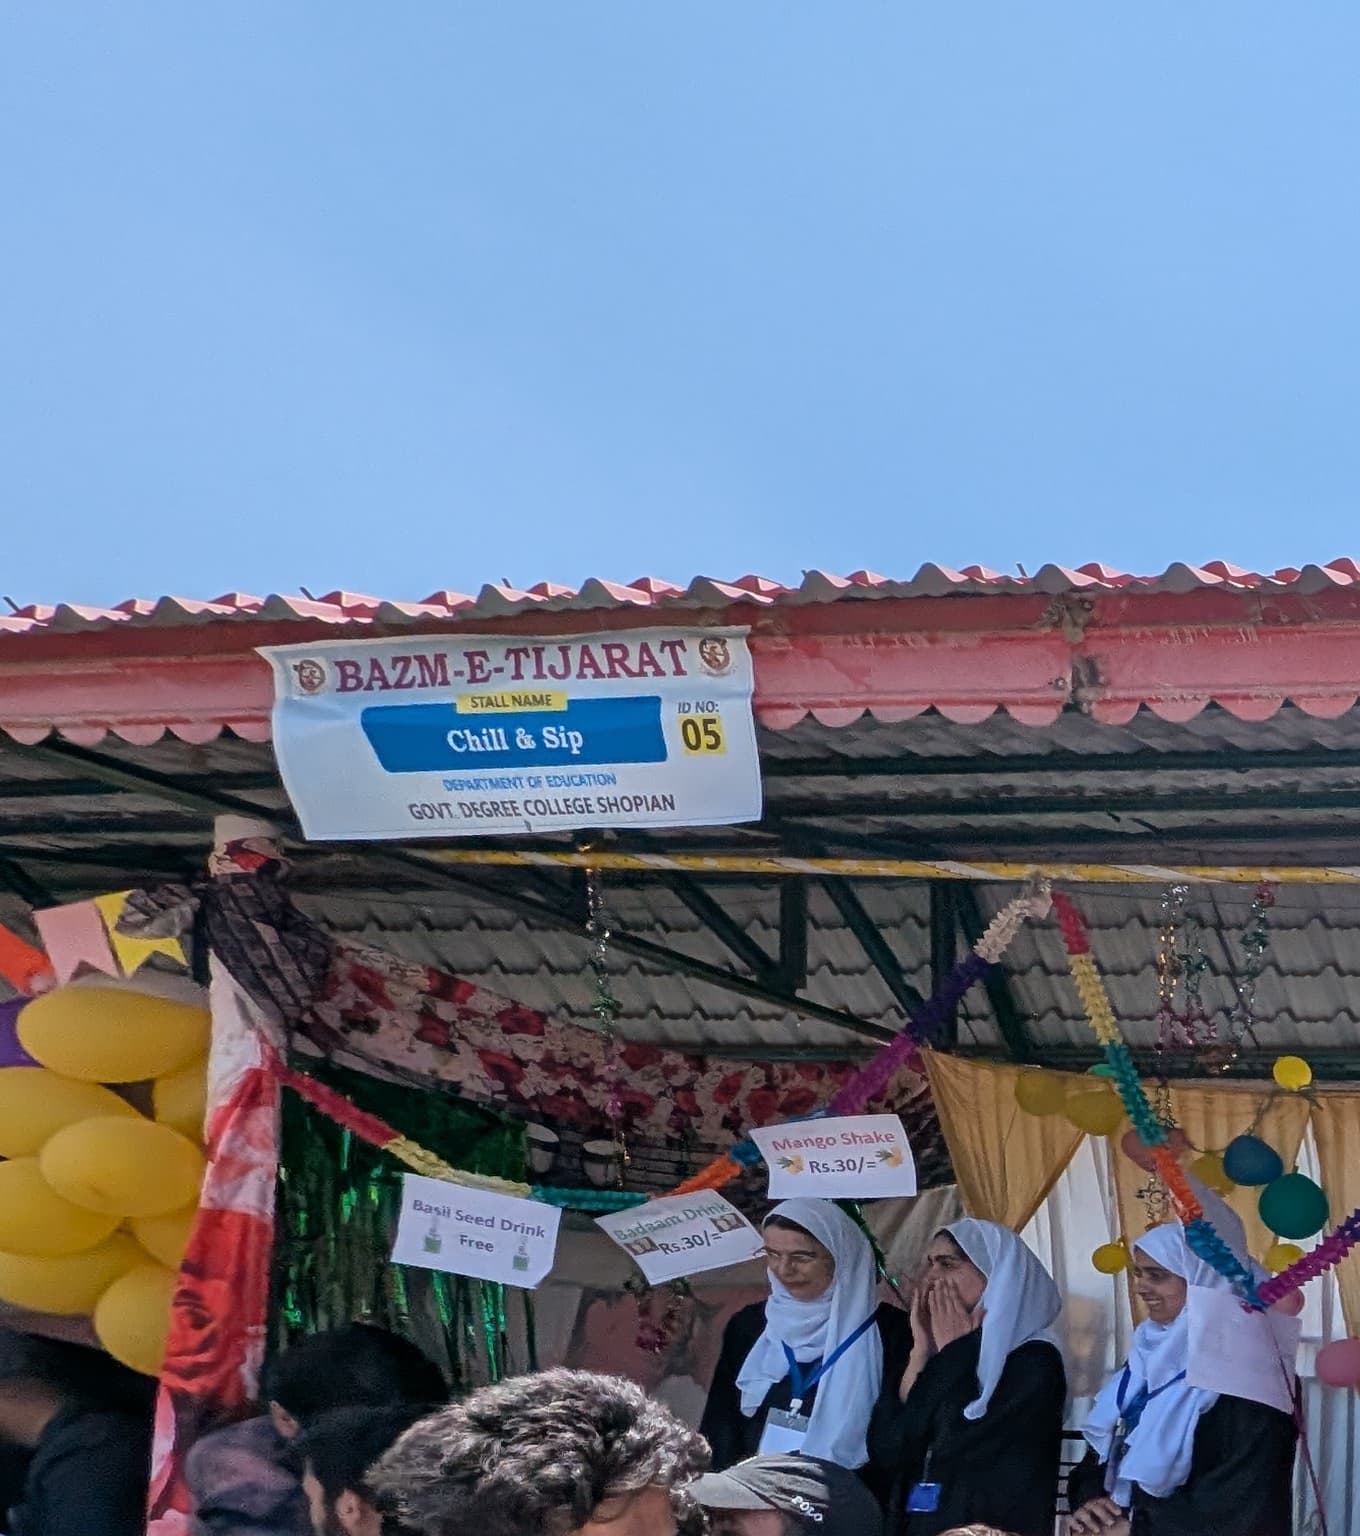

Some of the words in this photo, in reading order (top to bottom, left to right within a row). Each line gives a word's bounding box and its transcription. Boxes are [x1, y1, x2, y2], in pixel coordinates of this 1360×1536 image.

[334, 639, 688, 693] BAZM-E-TIJARAT
[470, 695, 510, 709] STALL
[511, 693, 552, 708] NAME
[677, 701, 692, 714] ID
[695, 700, 720, 714] NO:
[447, 727, 510, 753] Chill
[515, 727, 537, 750] &
[541, 725, 584, 755] Sip
[681, 717, 722, 751] 05
[442, 776, 524, 793] DEPARTMENT
[528, 775, 544, 789] OF
[546, 773, 618, 789] EDUCATION
[408, 803, 457, 821] GOVT.
[458, 800, 522, 819] DEGREE
[524, 797, 595, 817] COLLEGE
[597, 793, 676, 815] SHOPIAN
[771, 1136, 837, 1151] Mango
[841, 1131, 896, 1146] Shake
[808, 1156, 877, 1174] Rs.30/=
[412, 1199, 451, 1218] Basil
[455, 1209, 495, 1228] Seed
[500, 1219, 546, 1239] Drink
[613, 1214, 682, 1241] Badaam
[682, 1201, 730, 1221] Drink
[459, 1234, 495, 1252] Free
[658, 1229, 723, 1255] Rs.30/=
[791, 1495, 823, 1522] POLO
